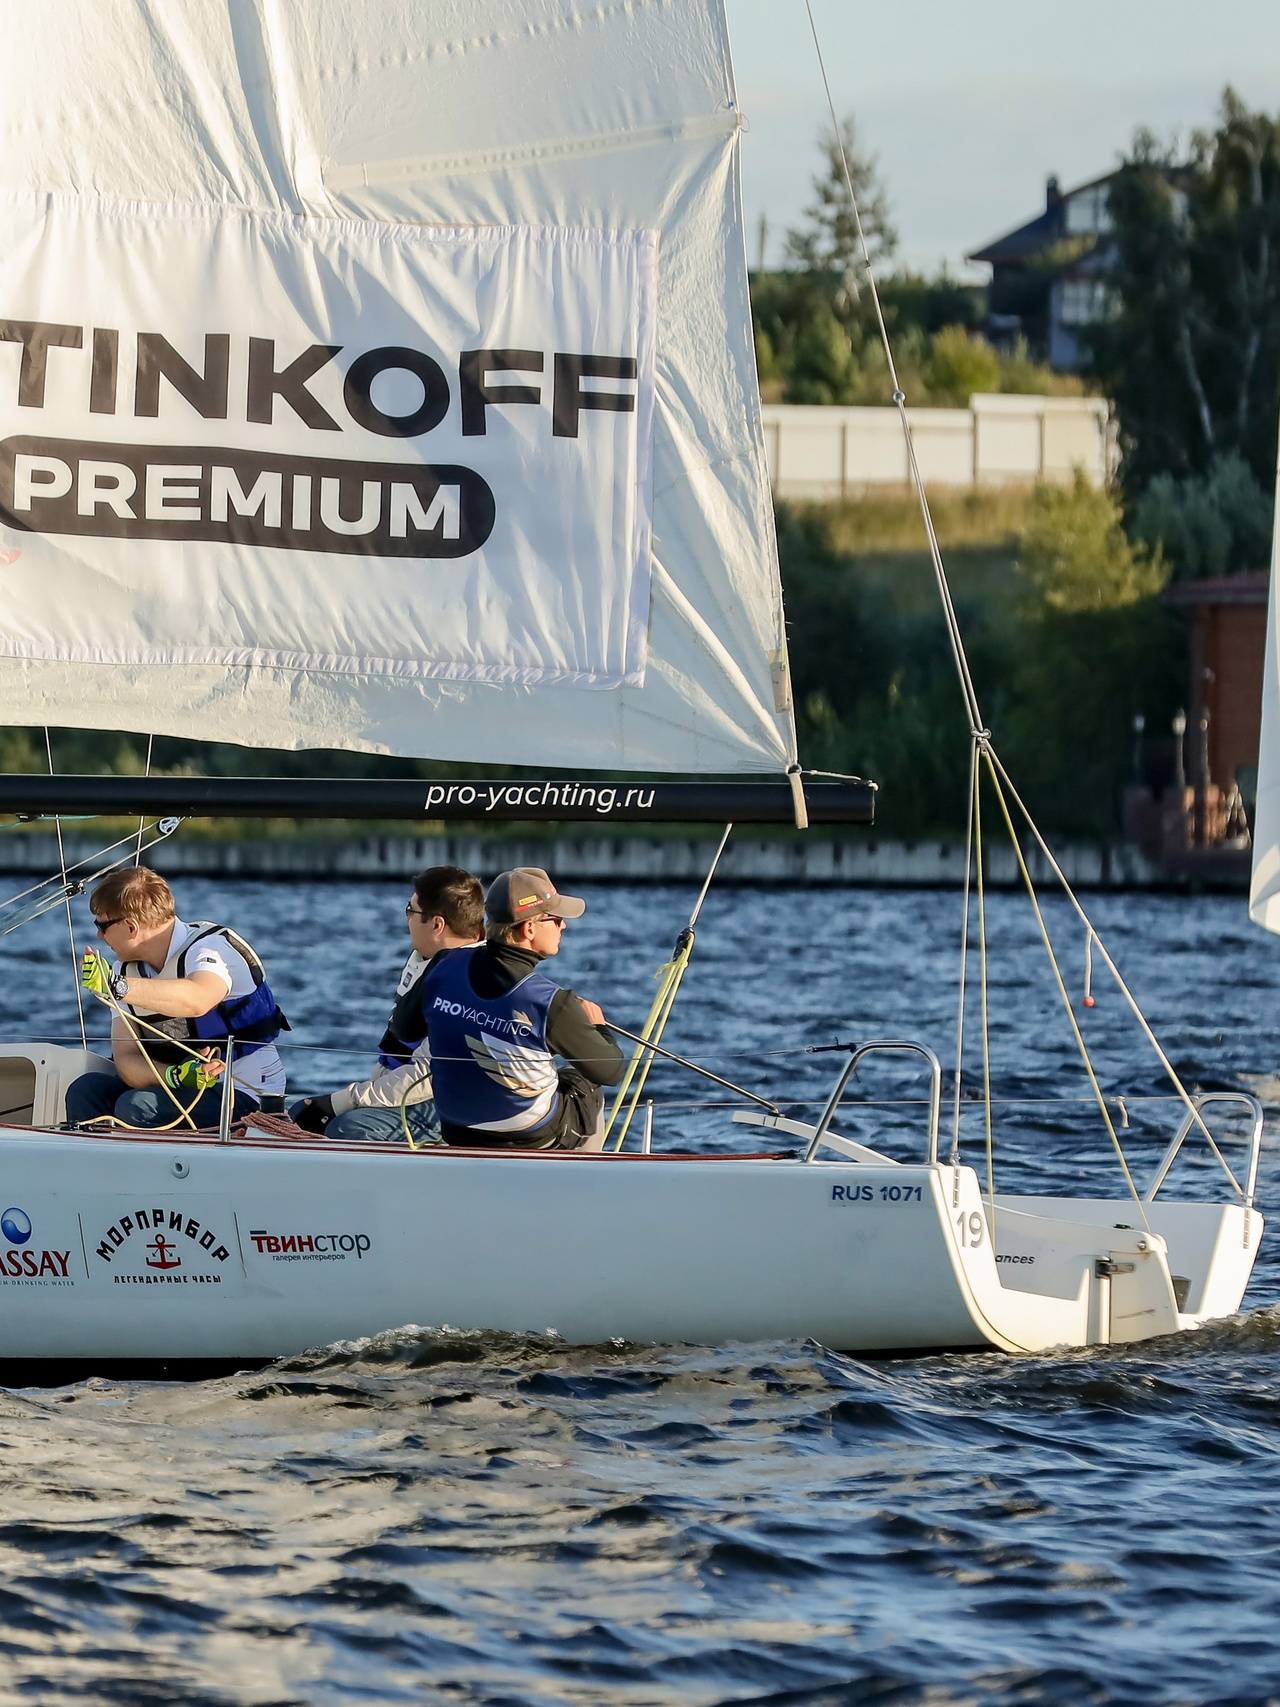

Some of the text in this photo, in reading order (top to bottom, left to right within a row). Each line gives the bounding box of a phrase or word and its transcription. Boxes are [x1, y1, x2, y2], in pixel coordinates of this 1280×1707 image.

[12, 453, 462, 540] PREMIUM
[424, 782, 656, 814] pro-yachting.ru
[832, 1185, 923, 1202] RUS 1071
[95, 1208, 230, 1263] МОРПРИБОР
[956, 1211, 985, 1249] 19
[302, 1253, 346, 1262] интерьеров
[995, 1254, 1036, 1265] ances
[114, 1275, 222, 1284] ЛЕГЕНДАРНЫЕ ЧАСЫ
